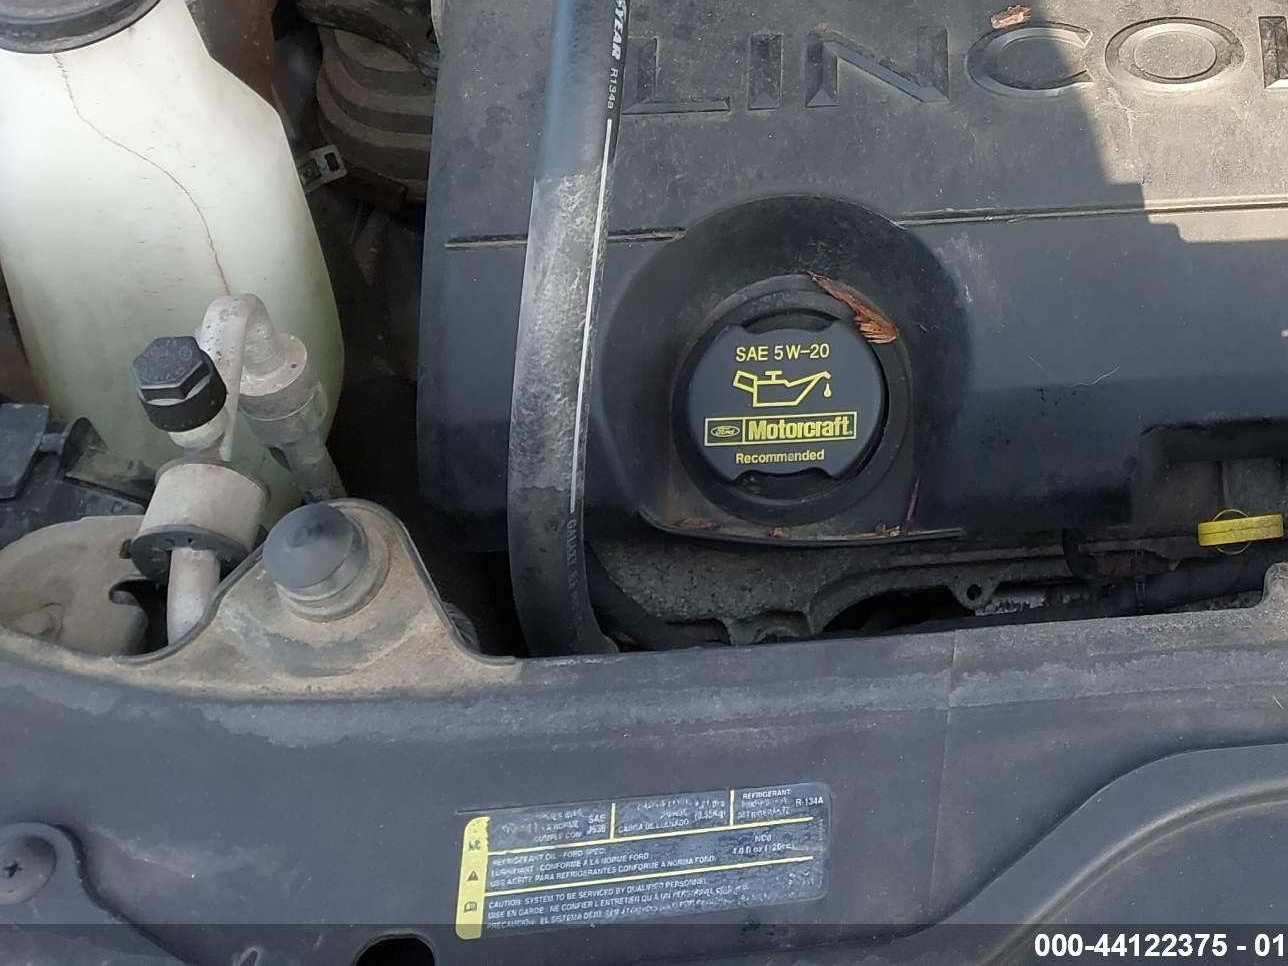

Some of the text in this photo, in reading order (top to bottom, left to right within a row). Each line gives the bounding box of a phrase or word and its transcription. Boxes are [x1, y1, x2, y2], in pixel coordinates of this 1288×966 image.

[736, 343, 830, 361] SAE 5W-20
[748, 416, 850, 440] Motorcraft
[736, 449, 825, 464] Recommended
[743, 789, 791, 799] REFRIGERANT
[795, 796, 824, 807] R-134A
[540, 861, 581, 871] CONFORME
[629, 852, 649, 862] FORD
[535, 874, 555, 883] PARA
[556, 866, 617, 880] REFRIGERANTES
[618, 862, 659, 873] CONFORME
[525, 895, 554, 905] SYSTEM
[567, 892, 577, 900] BE
[578, 888, 614, 898] SERVICED
[561, 901, 593, 911] CONFIER
